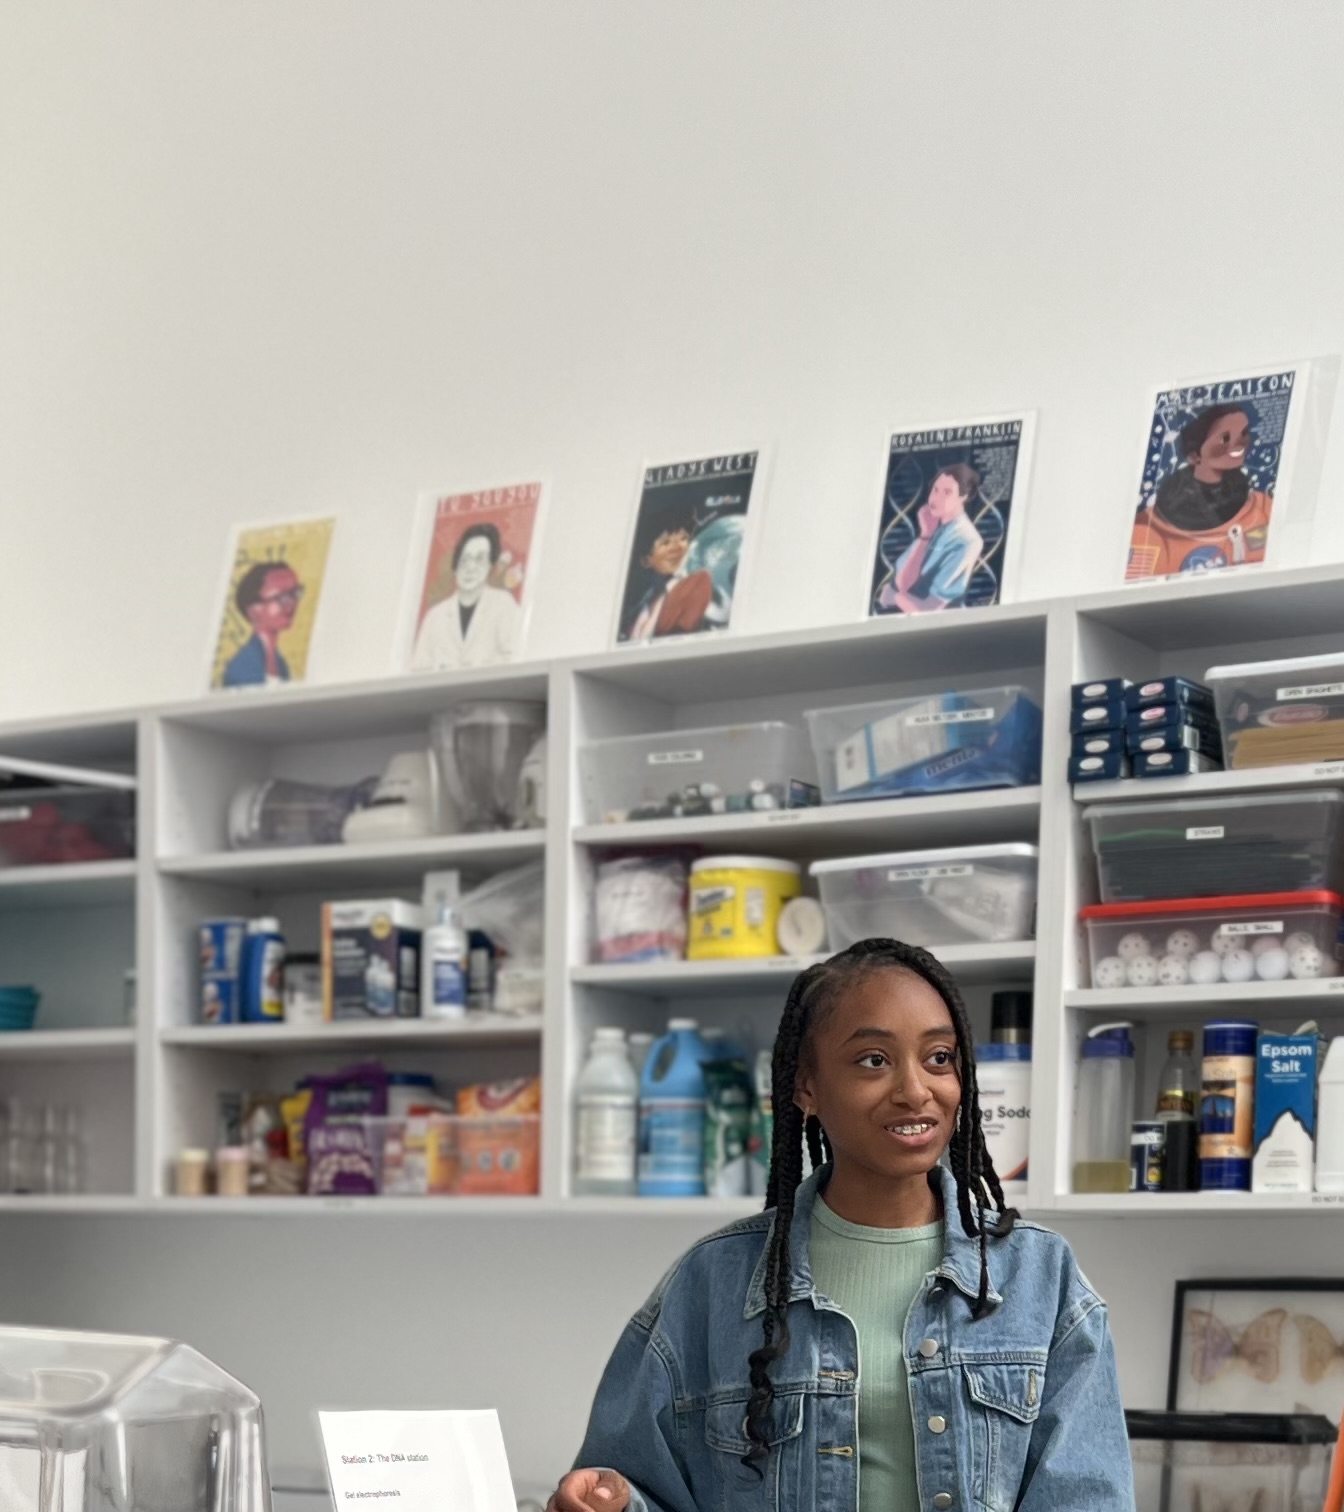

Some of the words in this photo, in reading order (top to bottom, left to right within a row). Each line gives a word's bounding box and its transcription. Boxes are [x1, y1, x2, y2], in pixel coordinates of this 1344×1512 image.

[1202, 374, 1293, 402] JEMISON
[891, 429, 954, 448] ROSALIND
[957, 421, 1022, 440] FRANKLIN
[713, 453, 756, 471] WEST
[1261, 1043, 1312, 1059] Epsom
[1272, 1060, 1301, 1073] Salt
[341, 1455, 367, 1464] Station
[367, 1454, 375, 1464] 2:
[376, 1453, 390, 1463] The
[390, 1453, 406, 1462] DNA
[406, 1453, 429, 1462] station
